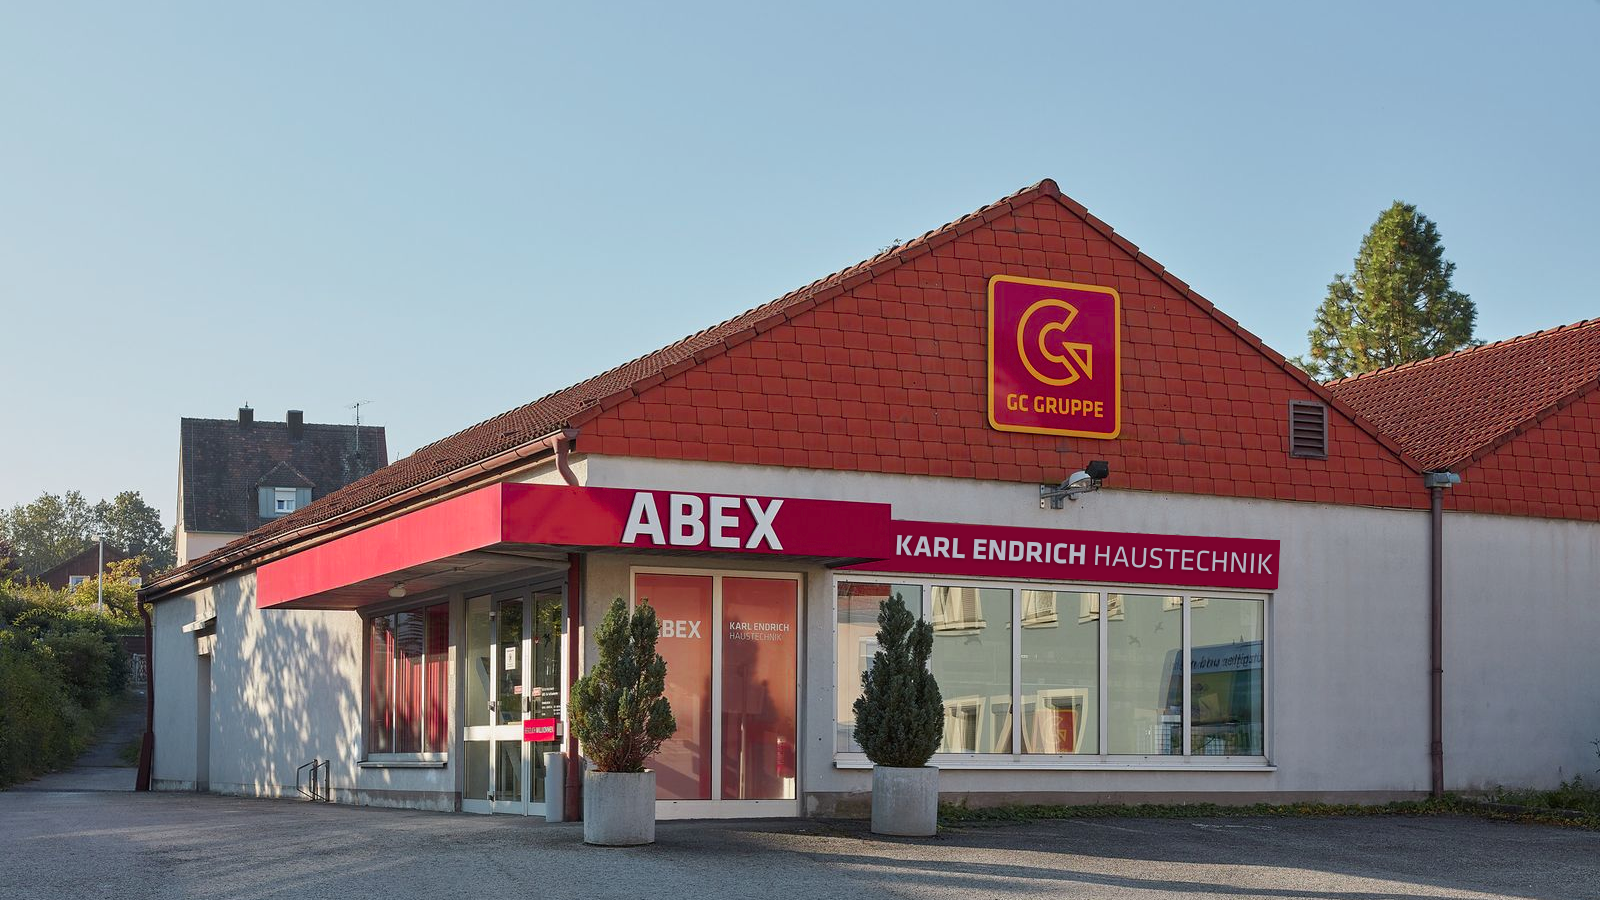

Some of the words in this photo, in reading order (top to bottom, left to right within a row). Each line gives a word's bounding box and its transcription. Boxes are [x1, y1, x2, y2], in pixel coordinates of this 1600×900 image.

[1006, 393, 1029, 412] GC
[1033, 395, 1104, 418] GRUPPE
[621, 491, 785, 551] ABEX
[895, 534, 966, 559] KARL
[972, 538, 1086, 565] ENDRICH
[1094, 544, 1273, 575] HAUSTECHNIK
[658, 619, 702, 639] BEX
[729, 621, 752, 631] KARL
[753, 622, 790, 632] ENDRICH
[729, 632, 783, 642] HAUSTECHNIK
